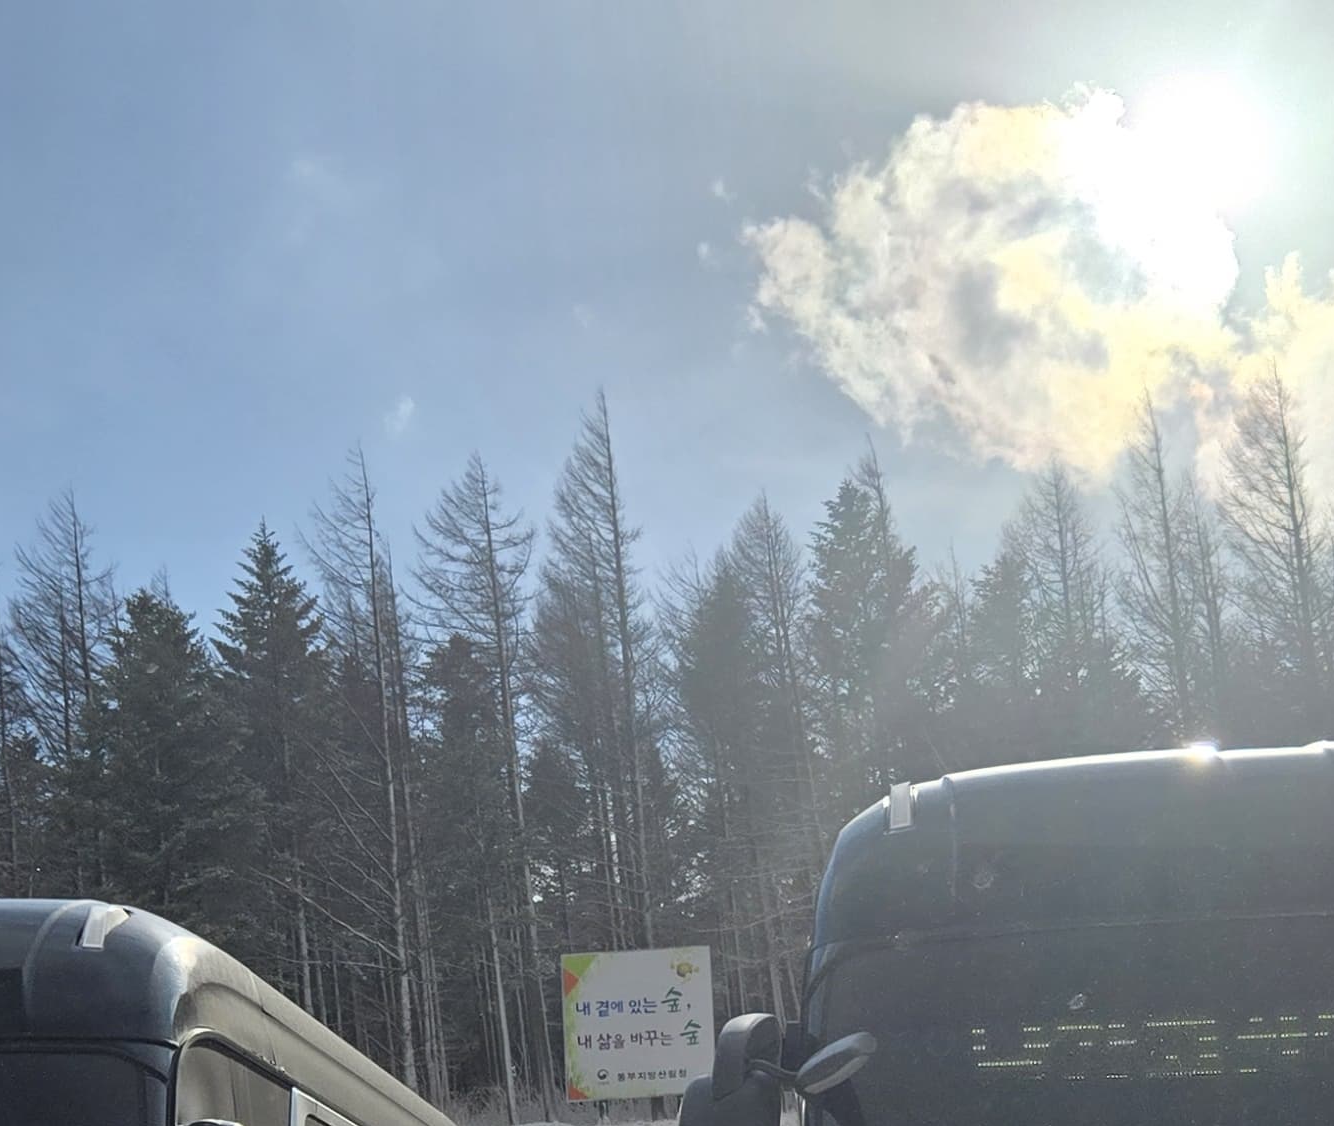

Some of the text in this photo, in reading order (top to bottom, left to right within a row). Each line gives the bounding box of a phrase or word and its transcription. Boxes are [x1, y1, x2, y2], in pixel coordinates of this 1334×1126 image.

[575, 1001, 591, 1016] 내
[595, 1000, 624, 1018] 곁에
[628, 997, 658, 1014] 있는
[577, 1019, 702, 1051] 내 삶을 바꾸는 숲
